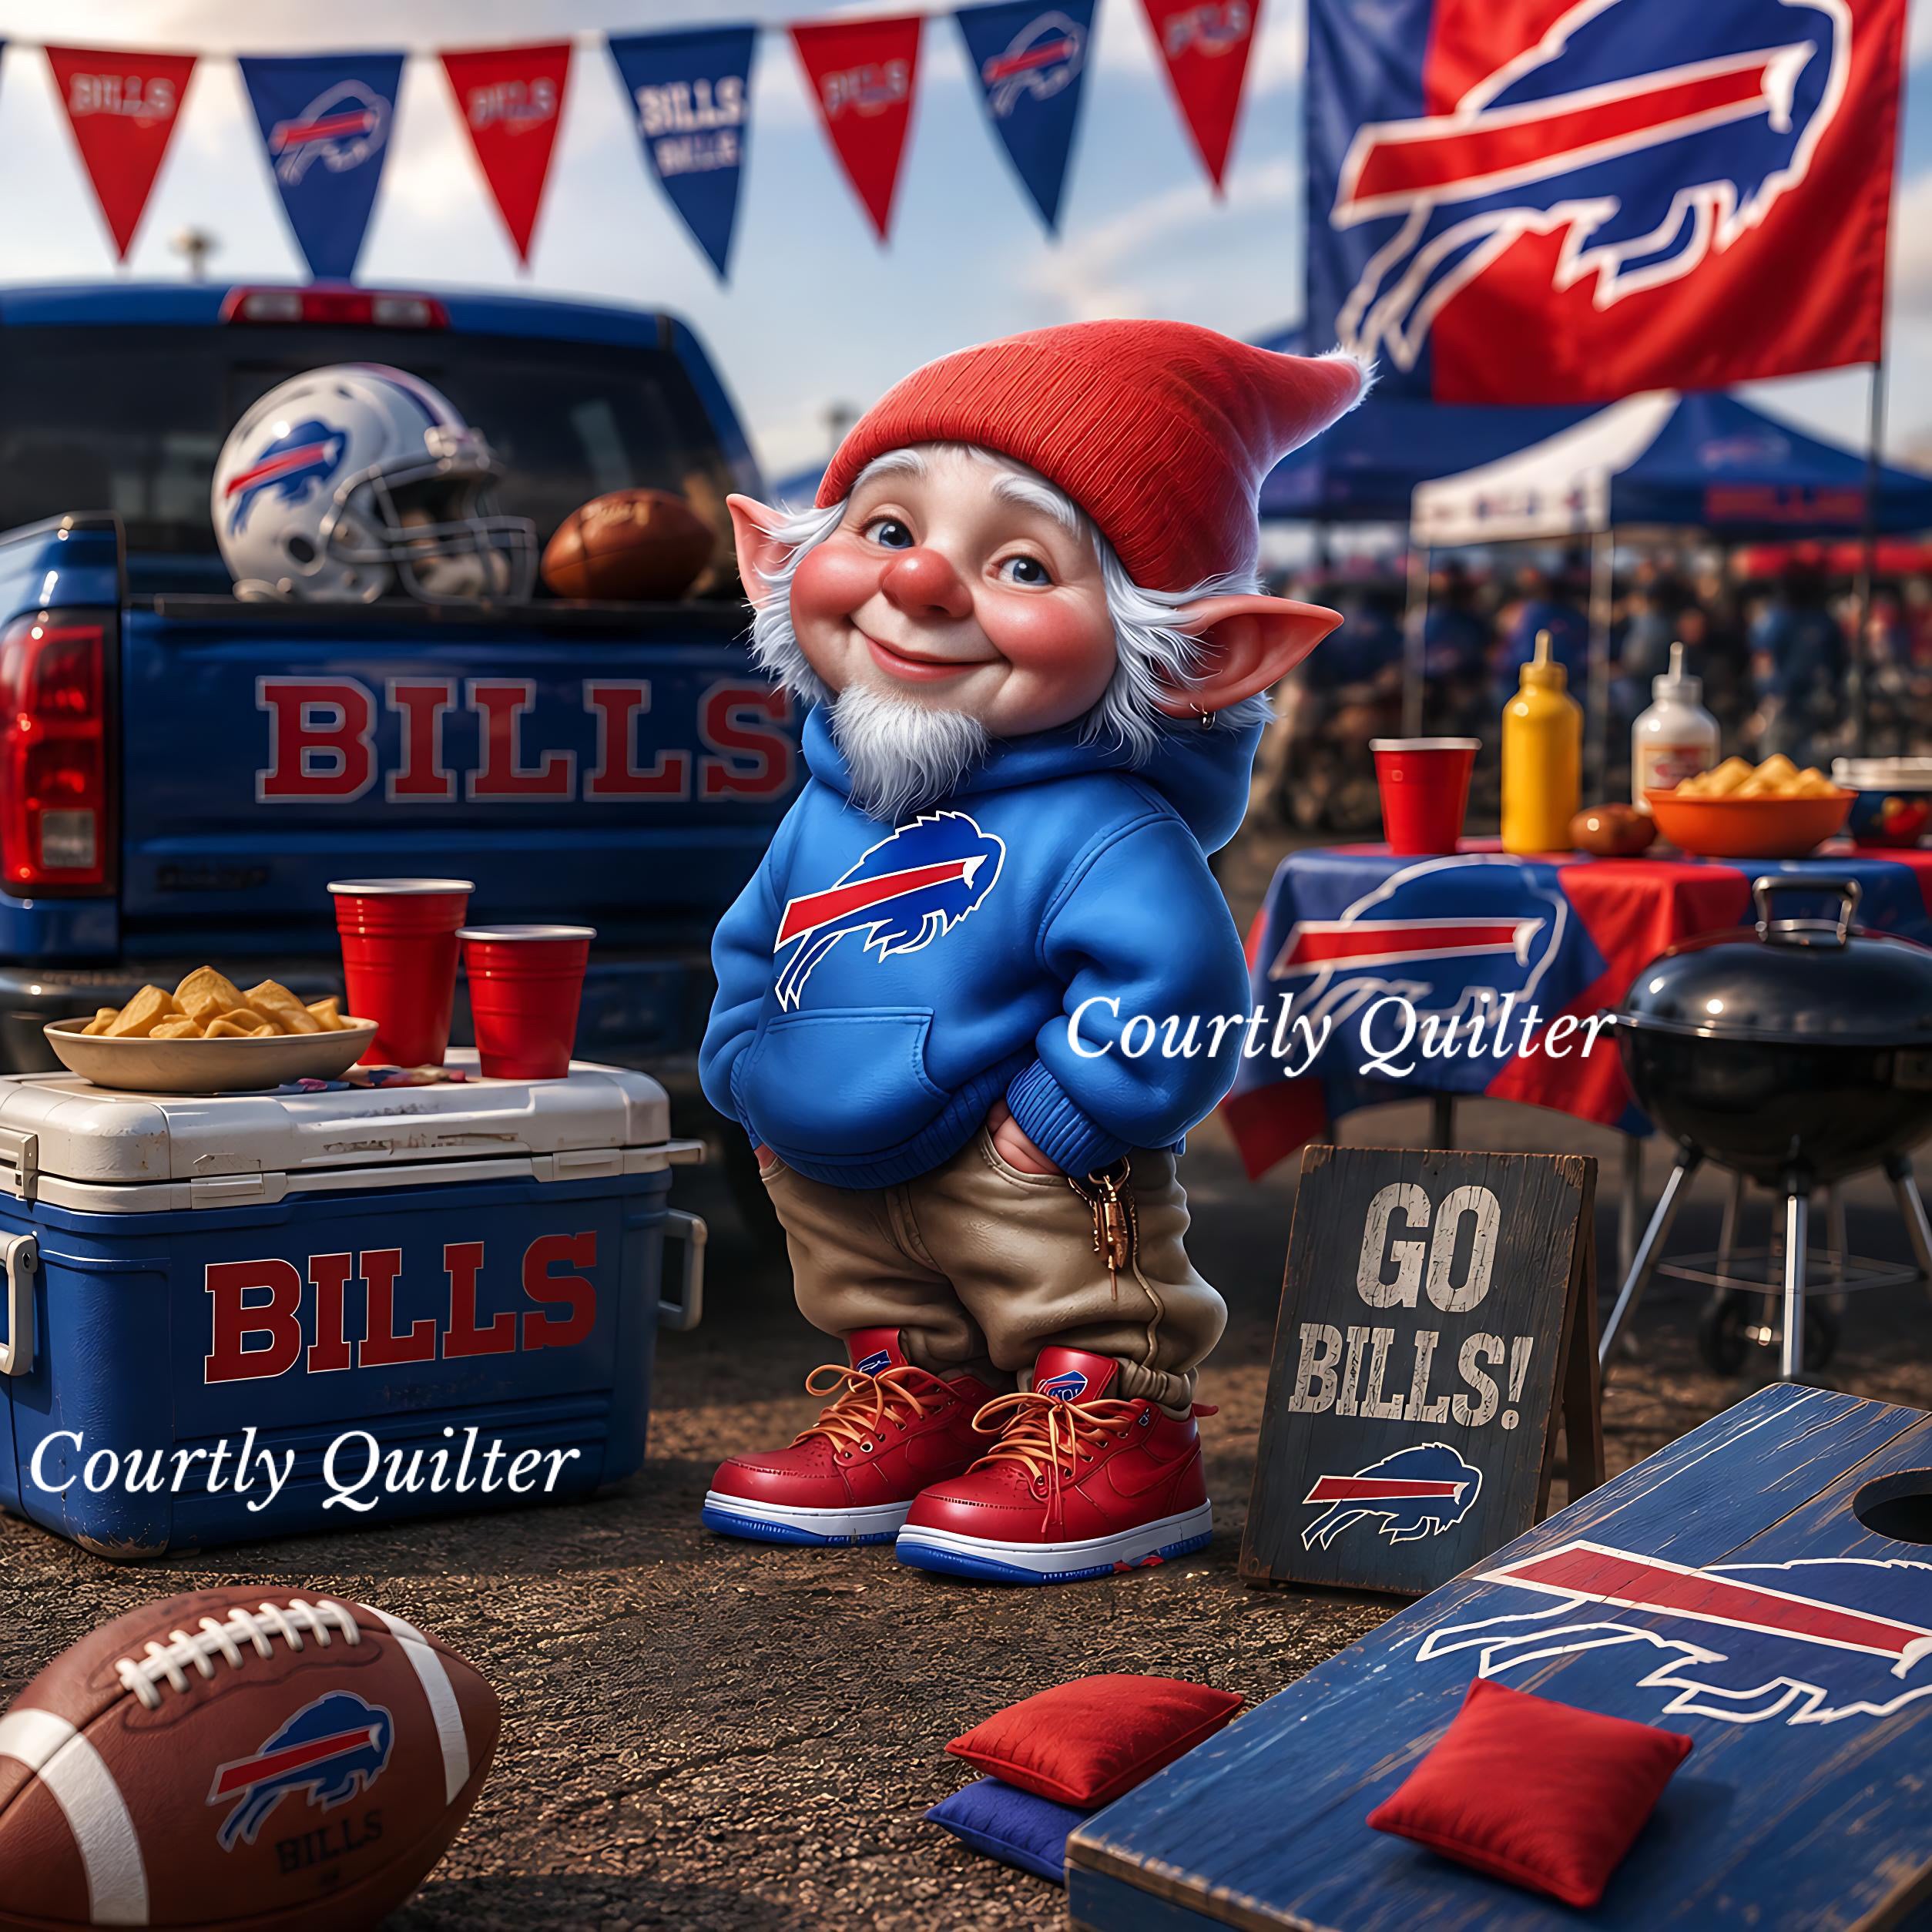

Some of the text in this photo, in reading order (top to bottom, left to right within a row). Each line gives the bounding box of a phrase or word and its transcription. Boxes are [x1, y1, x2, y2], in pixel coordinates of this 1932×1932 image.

[636, 75, 745, 136] BILLS
[255, 675, 796, 803] BILLS
[1356, 1182, 1501, 1312] GO
[205, 1231, 597, 1384] BILLS
[1288, 1323, 1534, 1430] BILLS!
[274, 1809, 384, 1873] BILLS
